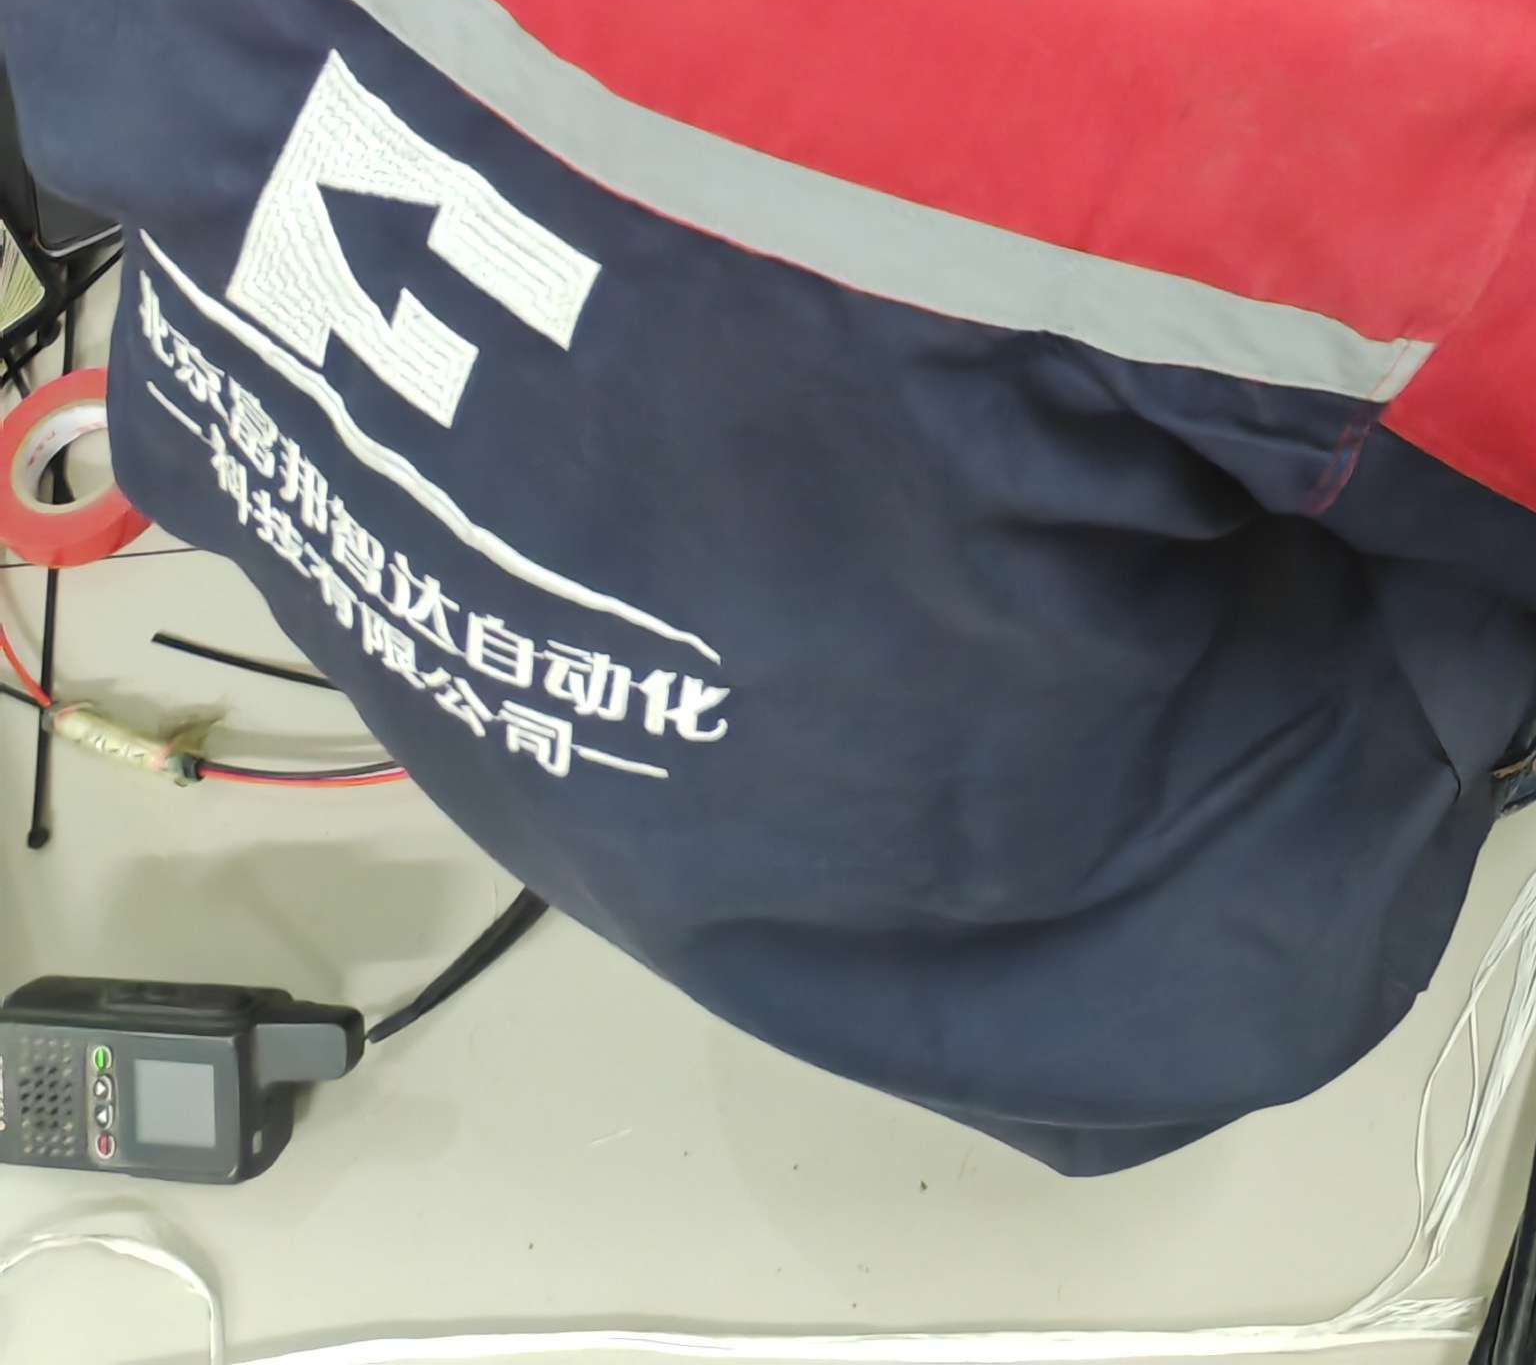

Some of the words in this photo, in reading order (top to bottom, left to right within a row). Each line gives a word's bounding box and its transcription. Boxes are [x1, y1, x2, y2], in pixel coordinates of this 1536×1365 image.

[140, 271, 730, 743] 北京富邦智达自动化
[210, 427, 574, 777] 科技有限公司
